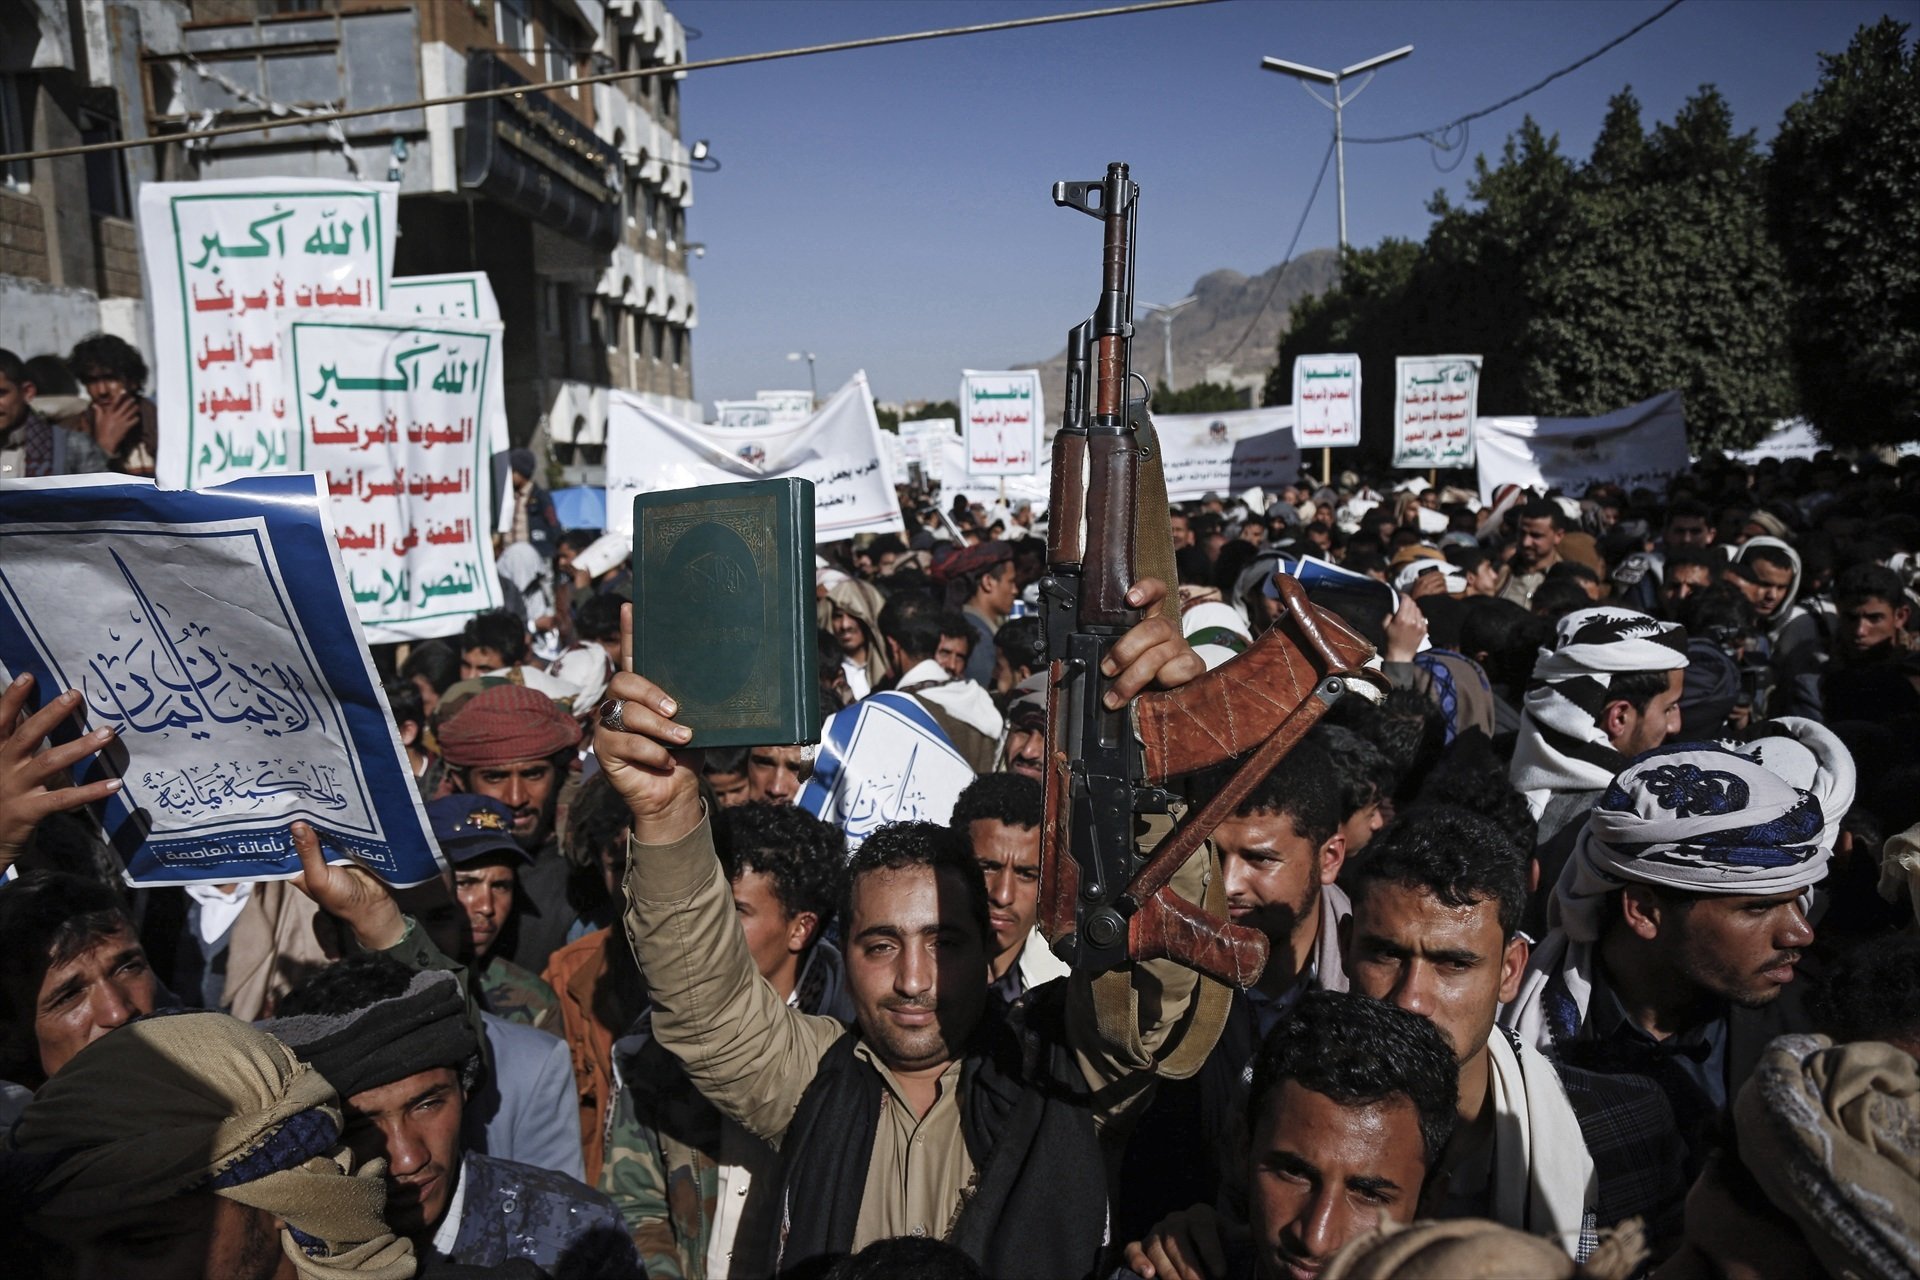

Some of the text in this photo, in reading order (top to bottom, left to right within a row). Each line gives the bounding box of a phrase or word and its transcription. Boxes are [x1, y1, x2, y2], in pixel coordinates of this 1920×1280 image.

[188, 203, 371, 275] الله أكبر
[308, 336, 480, 408] الله أكبر
[416, 560, 481, 609] النصر
[165, 844, 232, 861] العاصمة
[238, 836, 286, 856] بأمانة
